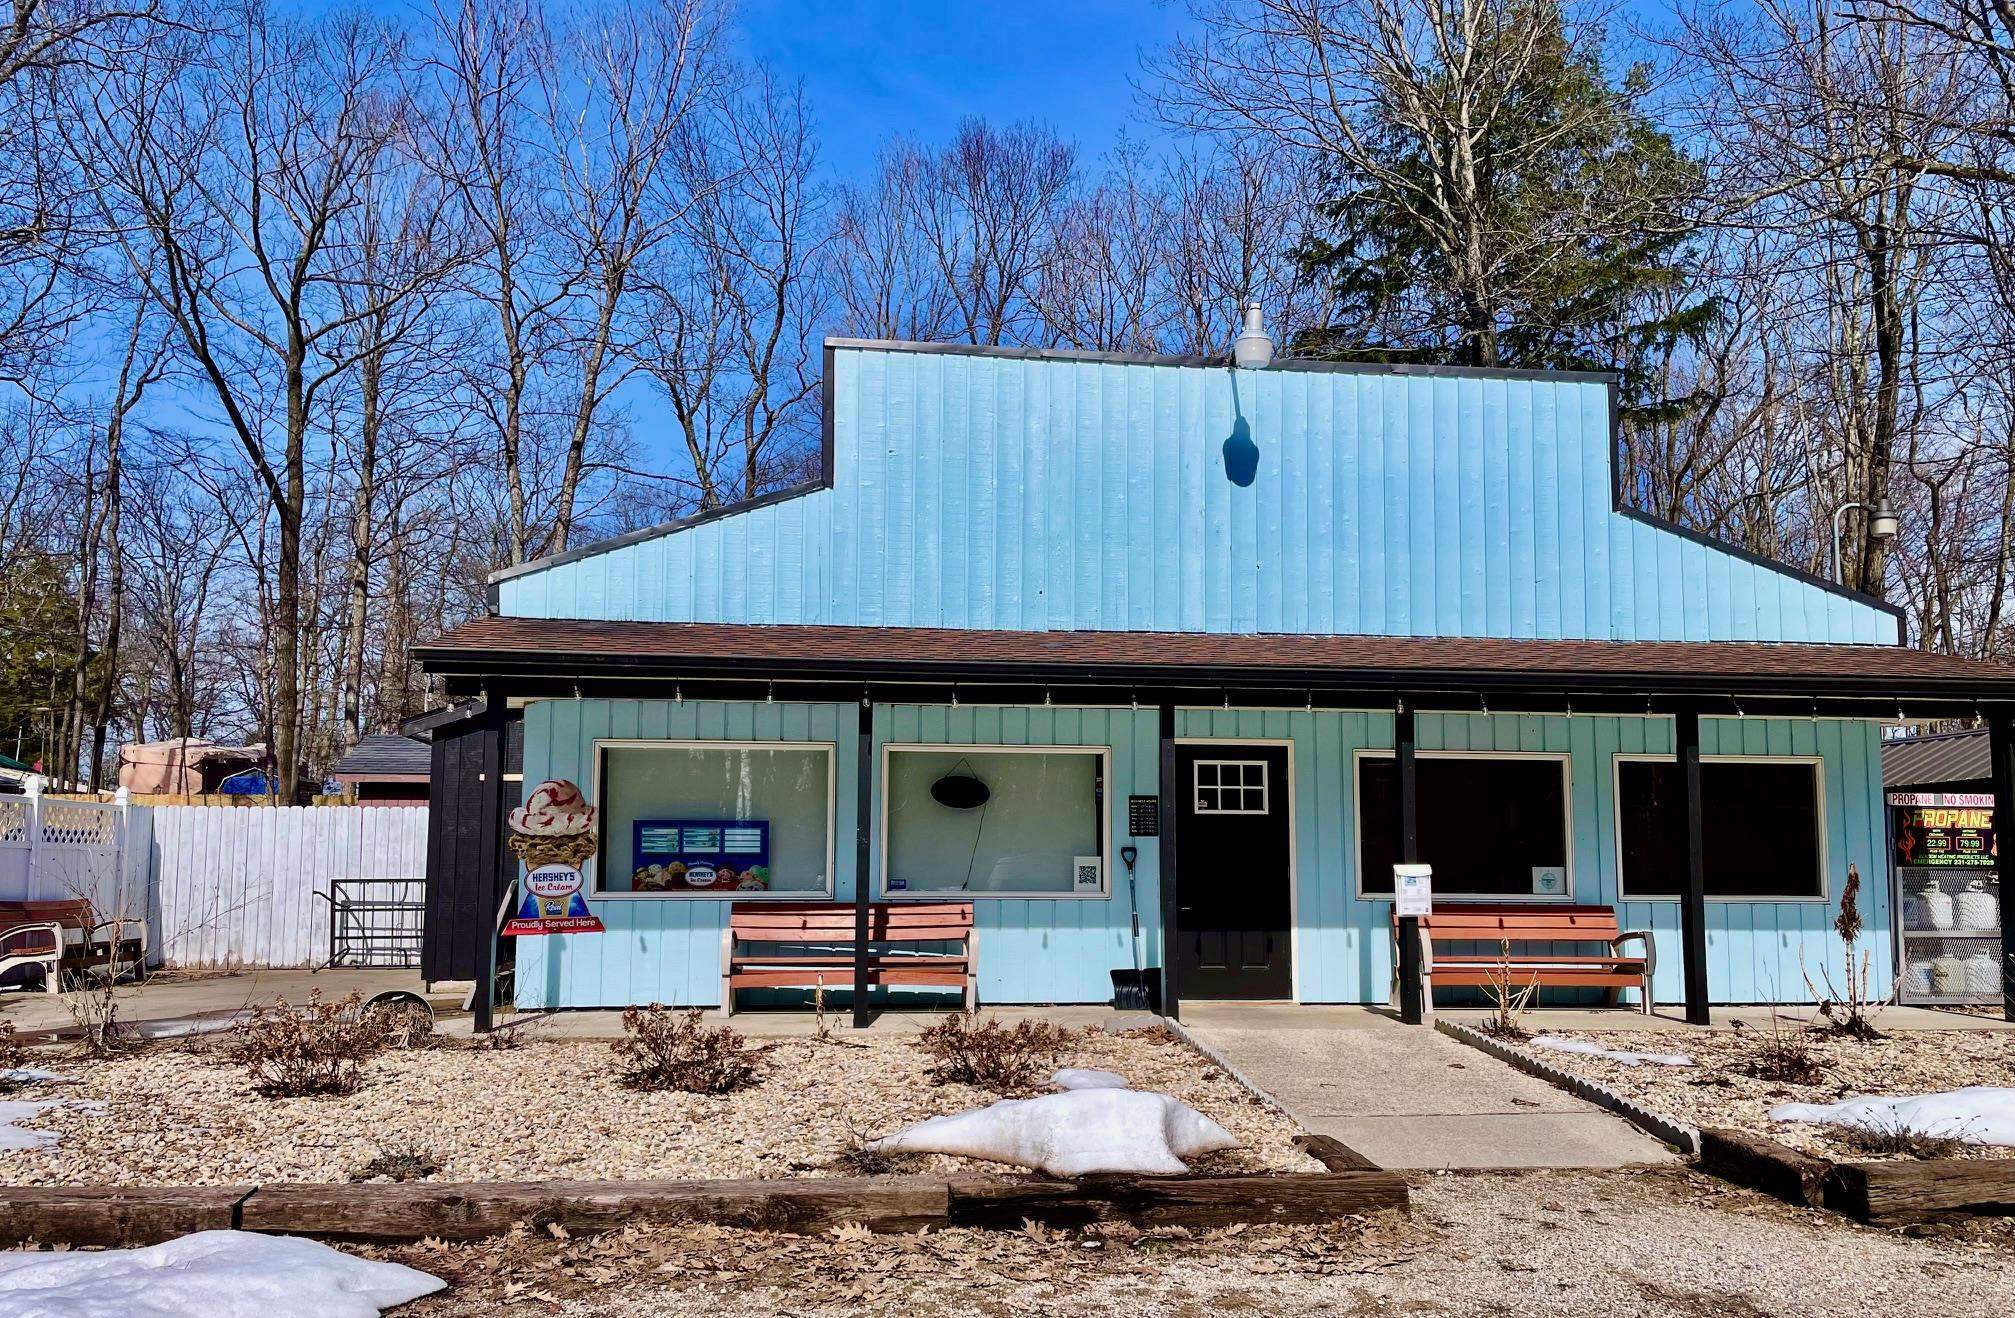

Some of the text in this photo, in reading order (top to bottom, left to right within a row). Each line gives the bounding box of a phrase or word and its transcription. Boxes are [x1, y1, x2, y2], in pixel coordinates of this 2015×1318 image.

[1892, 794, 1934, 805] PROPANE
[1943, 794, 1995, 805] NO SMOKIN
[1912, 809, 1994, 829] PROPANE
[1926, 839, 1947, 847] 22.99
[1960, 839, 1980, 847] 79.99
[532, 872, 575, 882] HERSHEY'S
[535, 882, 573, 891] Ice Cream
[511, 918, 596, 930] Proudly Served Here
